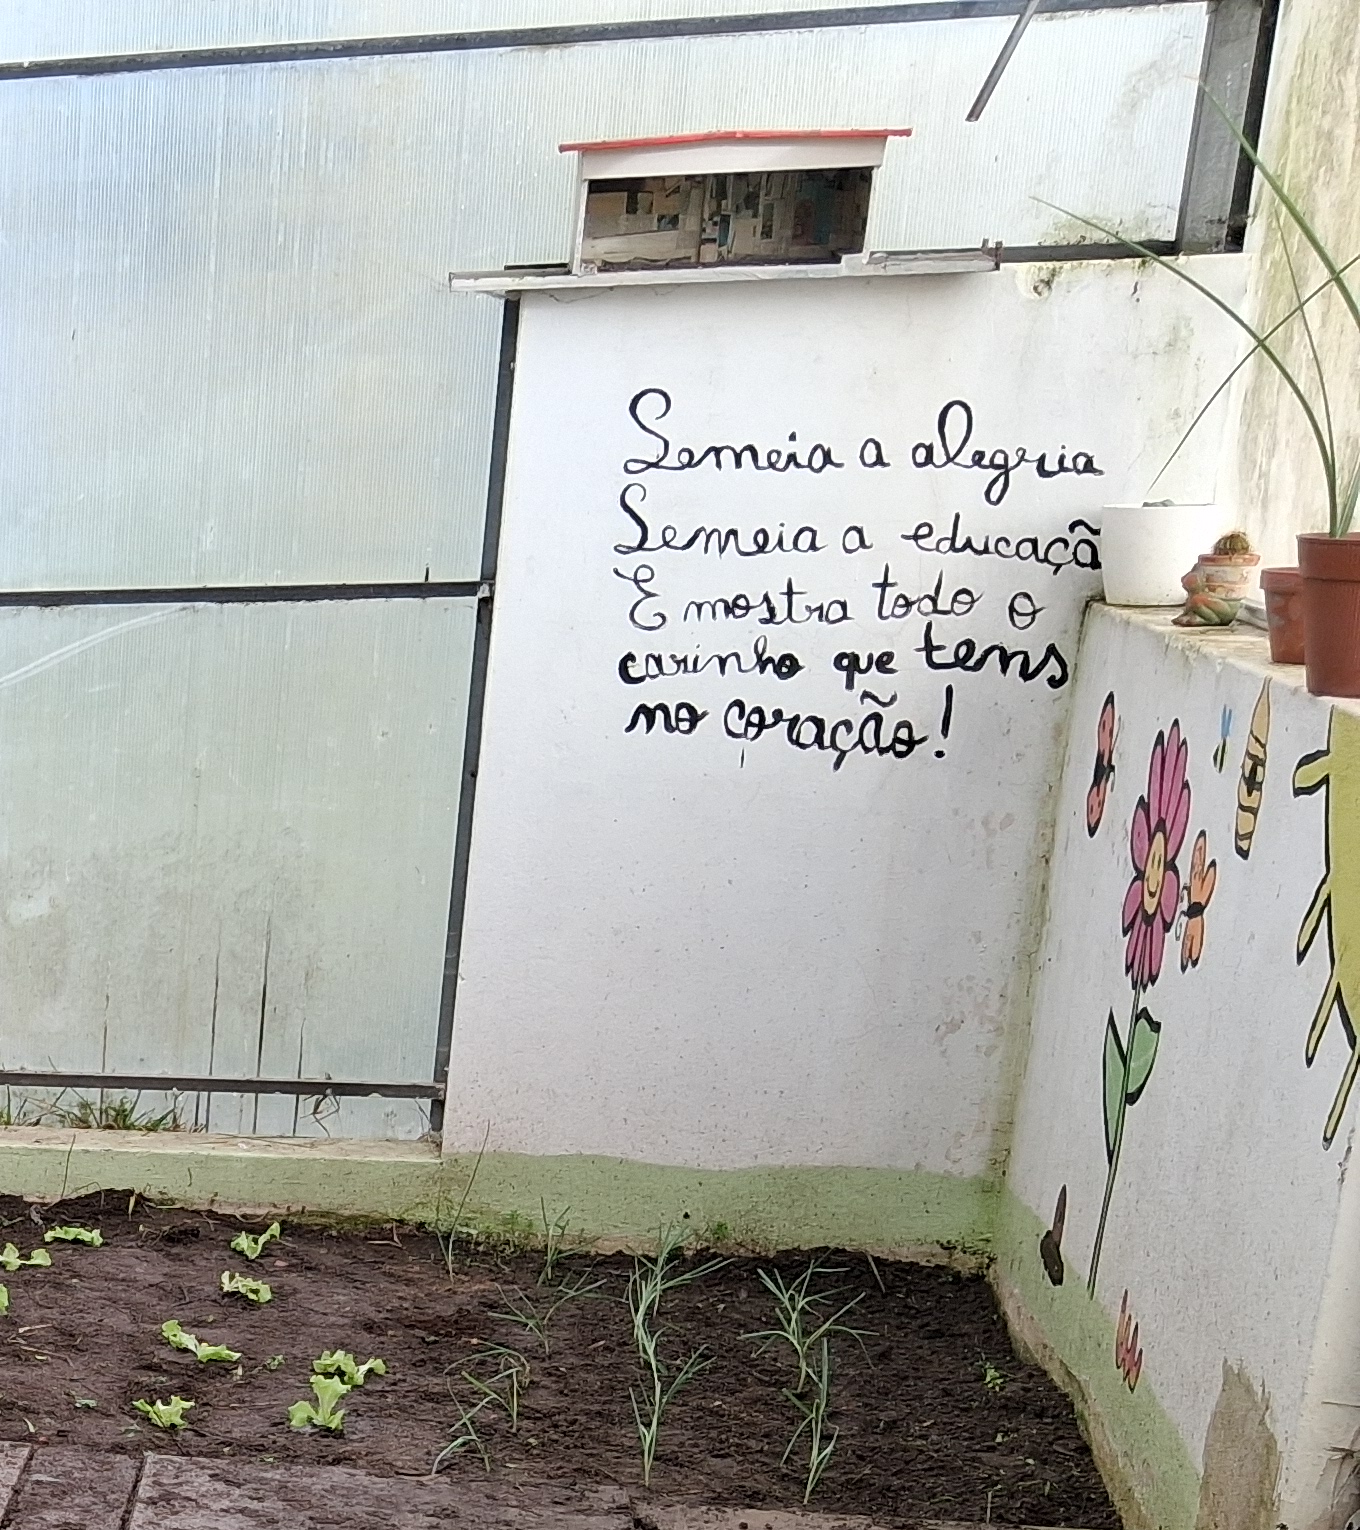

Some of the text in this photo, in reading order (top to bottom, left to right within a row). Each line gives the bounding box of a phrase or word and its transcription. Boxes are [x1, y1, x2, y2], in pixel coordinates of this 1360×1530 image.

[623, 388, 1106, 506] Semeia a alegria
[614, 482, 1102, 576] Semeia a educaçã
[612, 564, 667, 632] E
[683, 577, 855, 625] mostra
[871, 563, 984, 621] todo
[618, 620, 1070, 691] carinho que tens
[624, 683, 955, 772] no coração!
